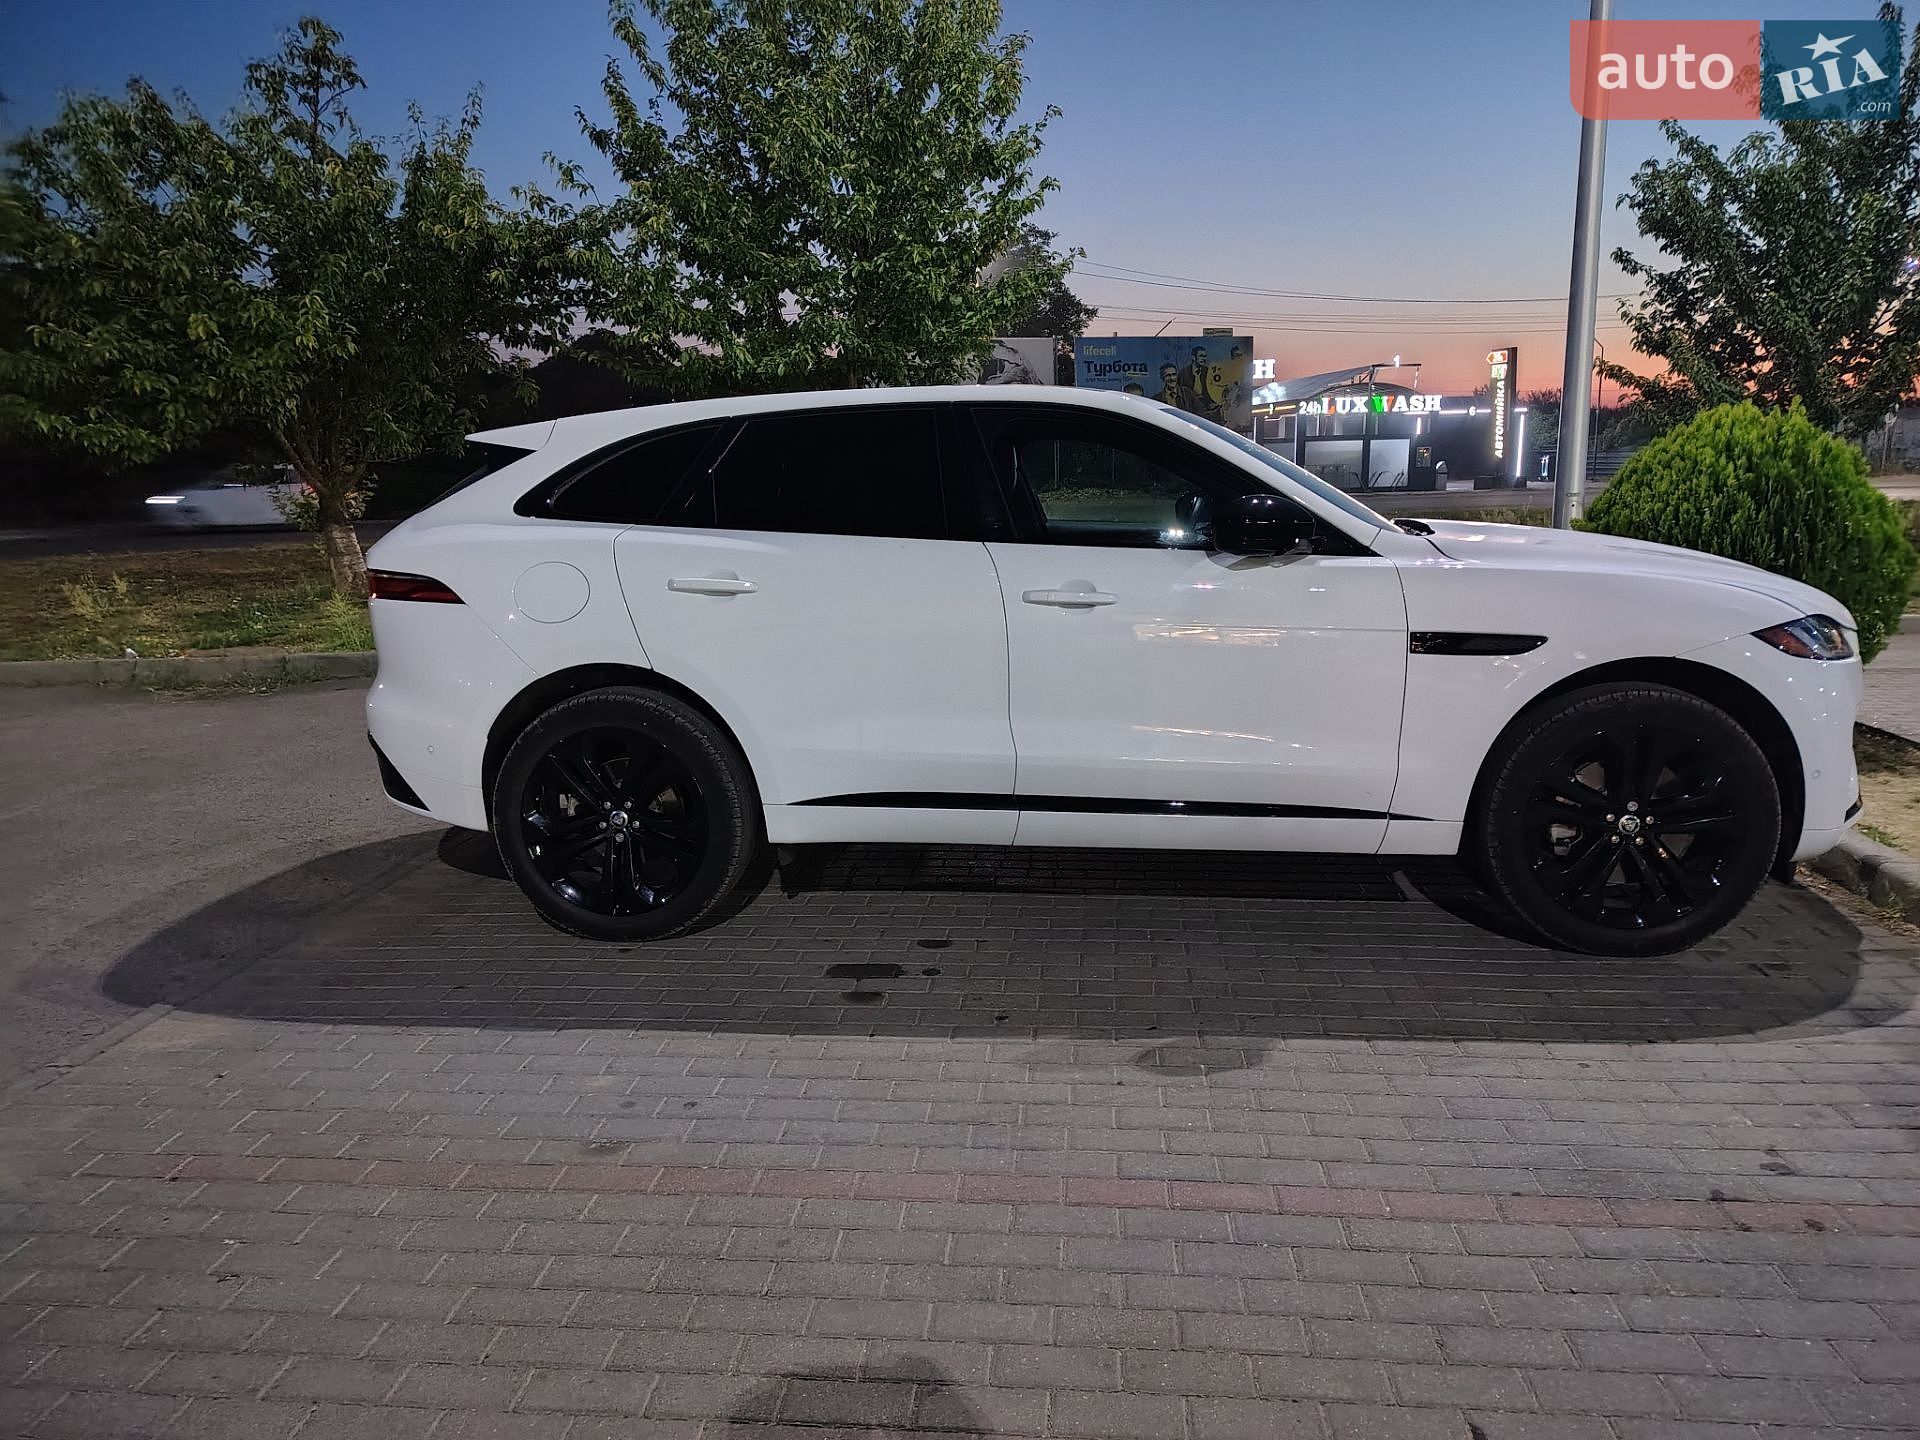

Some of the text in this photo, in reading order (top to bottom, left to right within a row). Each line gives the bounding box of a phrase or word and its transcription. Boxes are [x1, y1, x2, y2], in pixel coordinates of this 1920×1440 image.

[1083, 345, 1117, 356] lifecell
[1084, 360, 1148, 376] Турбота
[1393, 354, 1400, 368] 1
[1321, 396, 1368, 414] LUX
[1371, 395, 1442, 412] WASH
